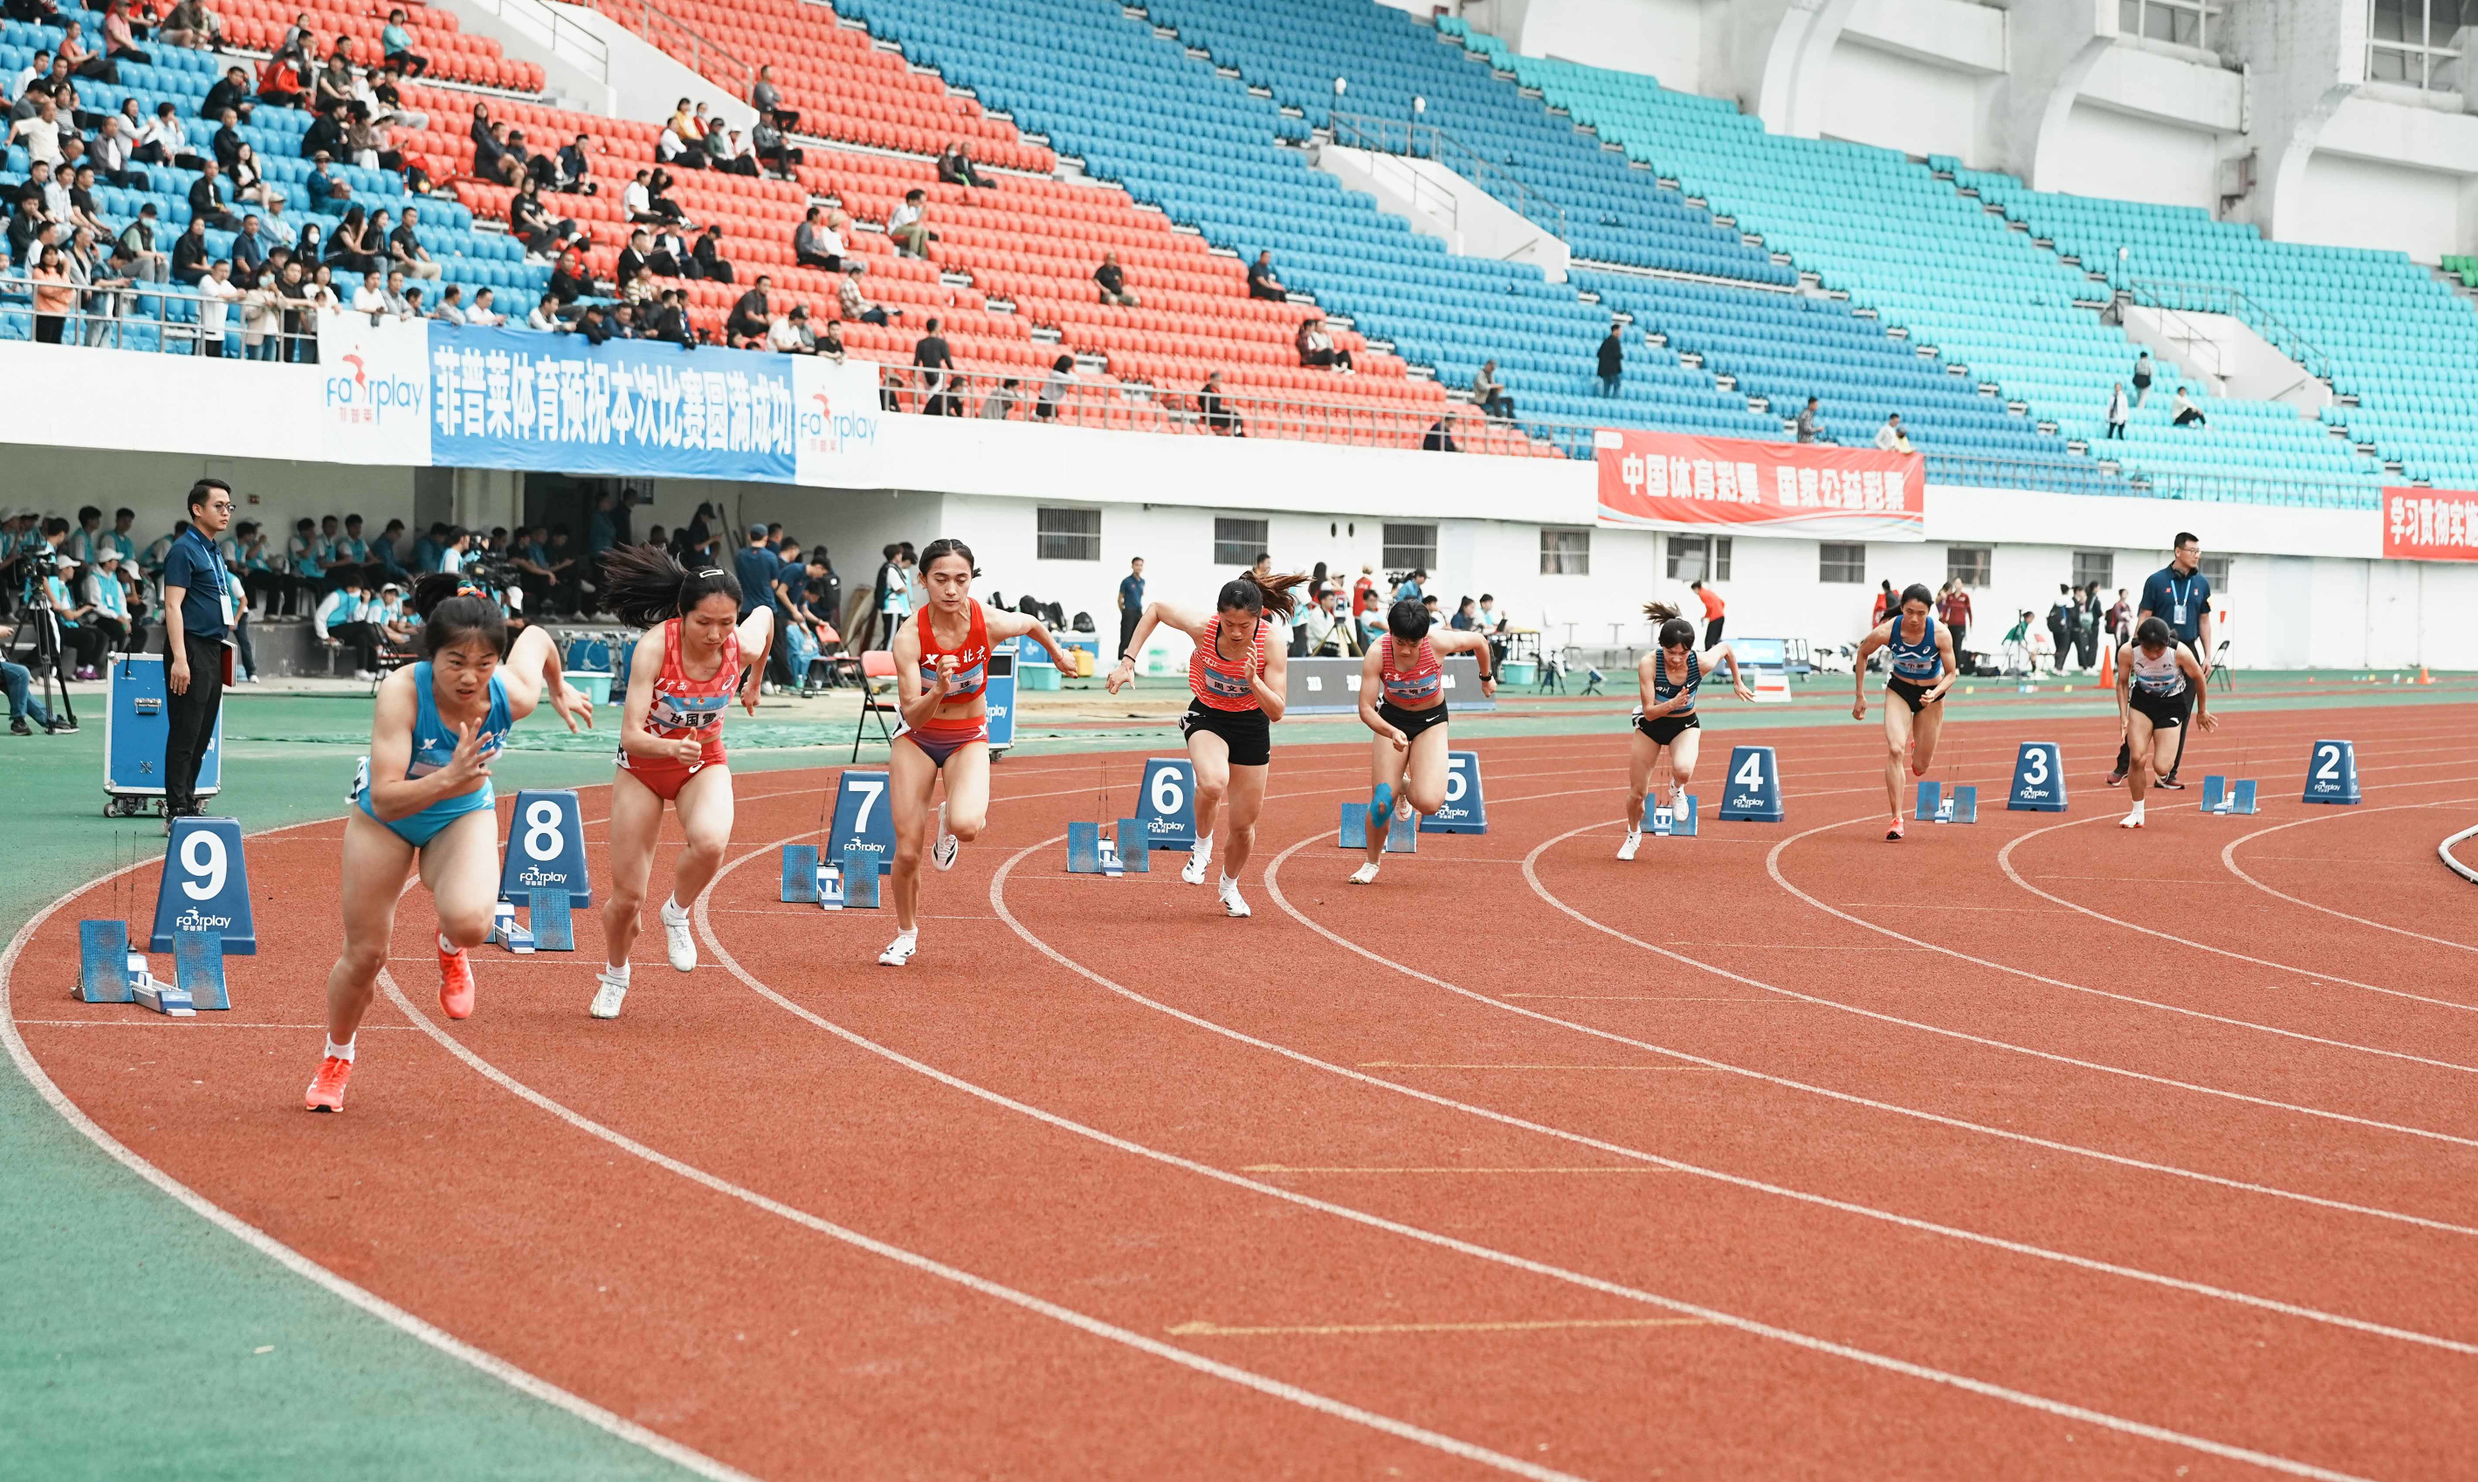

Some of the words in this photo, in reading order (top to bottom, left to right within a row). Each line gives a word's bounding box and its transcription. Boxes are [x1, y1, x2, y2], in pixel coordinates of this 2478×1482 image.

[433, 344, 792, 455] 菲普莱体育预祝本次比赛圆满成功
[1622, 452, 1761, 505] 中国体育彩票
[1776, 465, 1905, 511] 国家公益彩票
[963, 645, 986, 663] 北京
[664, 680, 687, 691] 广西
[1444, 758, 1467, 802] 5
[1735, 753, 1764, 792] 4
[2023, 748, 2048, 785] 3
[2316, 745, 2340, 779] 2
[848, 781, 884, 833] 7
[1151, 766, 1184, 815] 6
[523, 800, 564, 861] 8
[180, 830, 227, 901] 9
